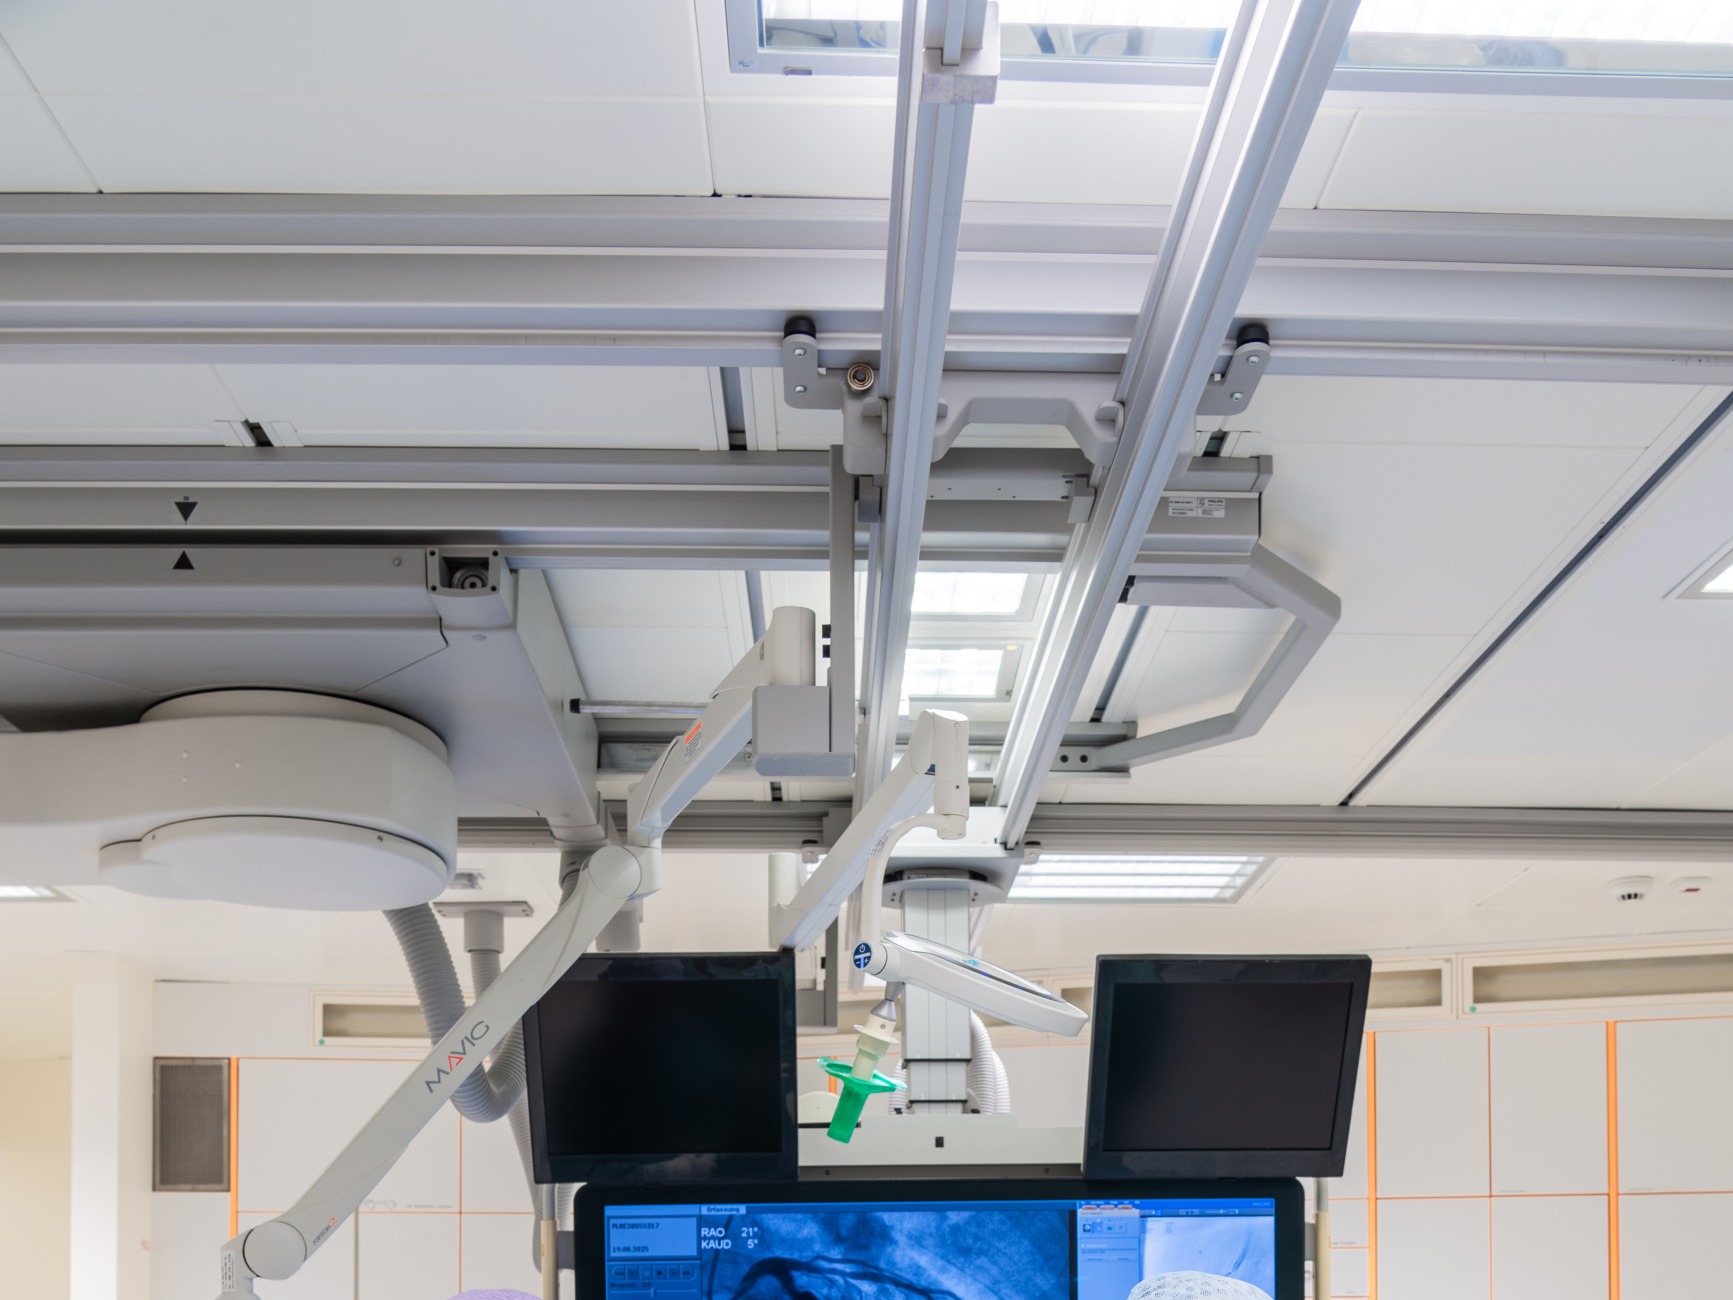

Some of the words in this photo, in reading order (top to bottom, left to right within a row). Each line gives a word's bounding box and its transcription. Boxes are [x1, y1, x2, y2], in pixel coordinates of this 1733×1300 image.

[424, 1020, 490, 1094] MAVIG
[706, 1206, 740, 1214] Erfassung
[701, 1227, 726, 1238] RAO
[741, 1227, 758, 1237] 21°
[701, 1239, 732, 1249] KAUD
[747, 1239, 758, 1249] 5°
